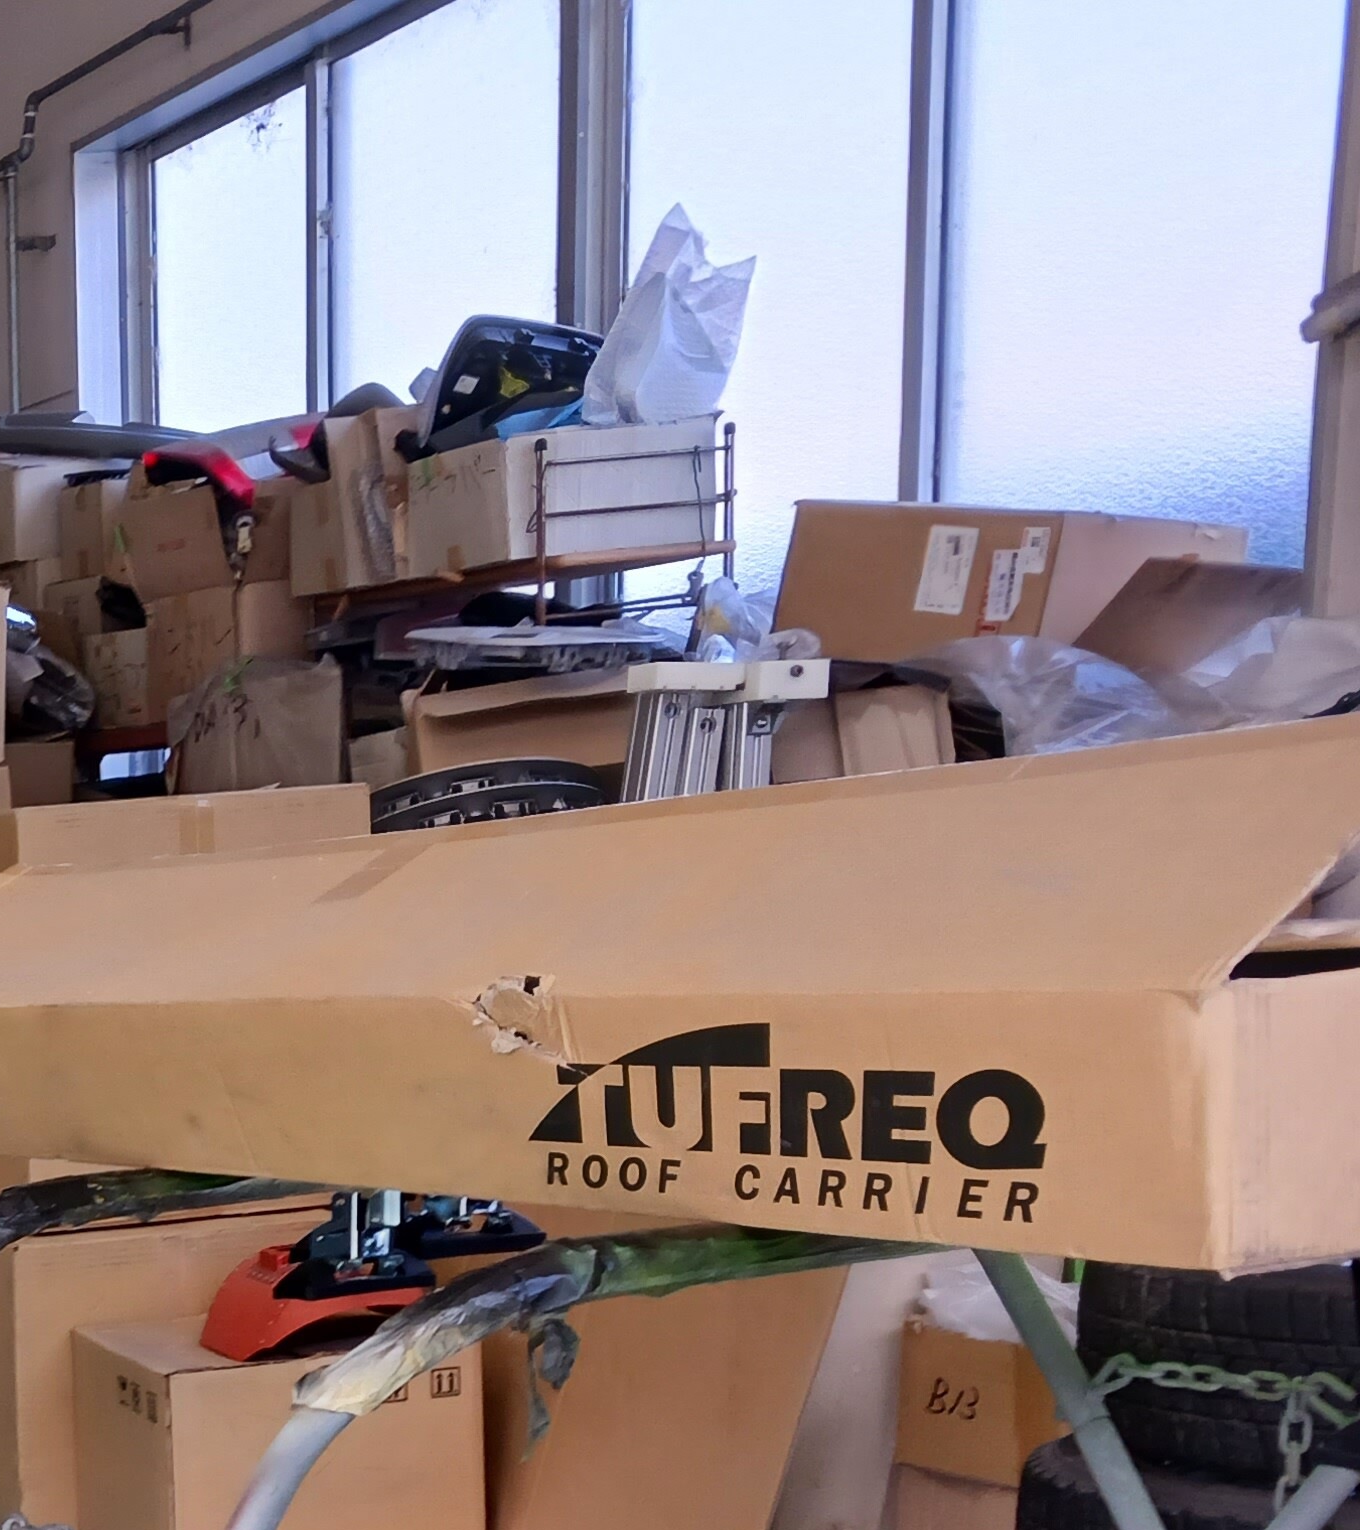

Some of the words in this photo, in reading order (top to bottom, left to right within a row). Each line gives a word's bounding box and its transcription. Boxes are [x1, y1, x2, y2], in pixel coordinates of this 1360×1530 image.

[528, 1023, 1047, 1170] TUFREQ
[547, 1152, 681, 1194] ROOF
[734, 1164, 1040, 1223] CARRIER
